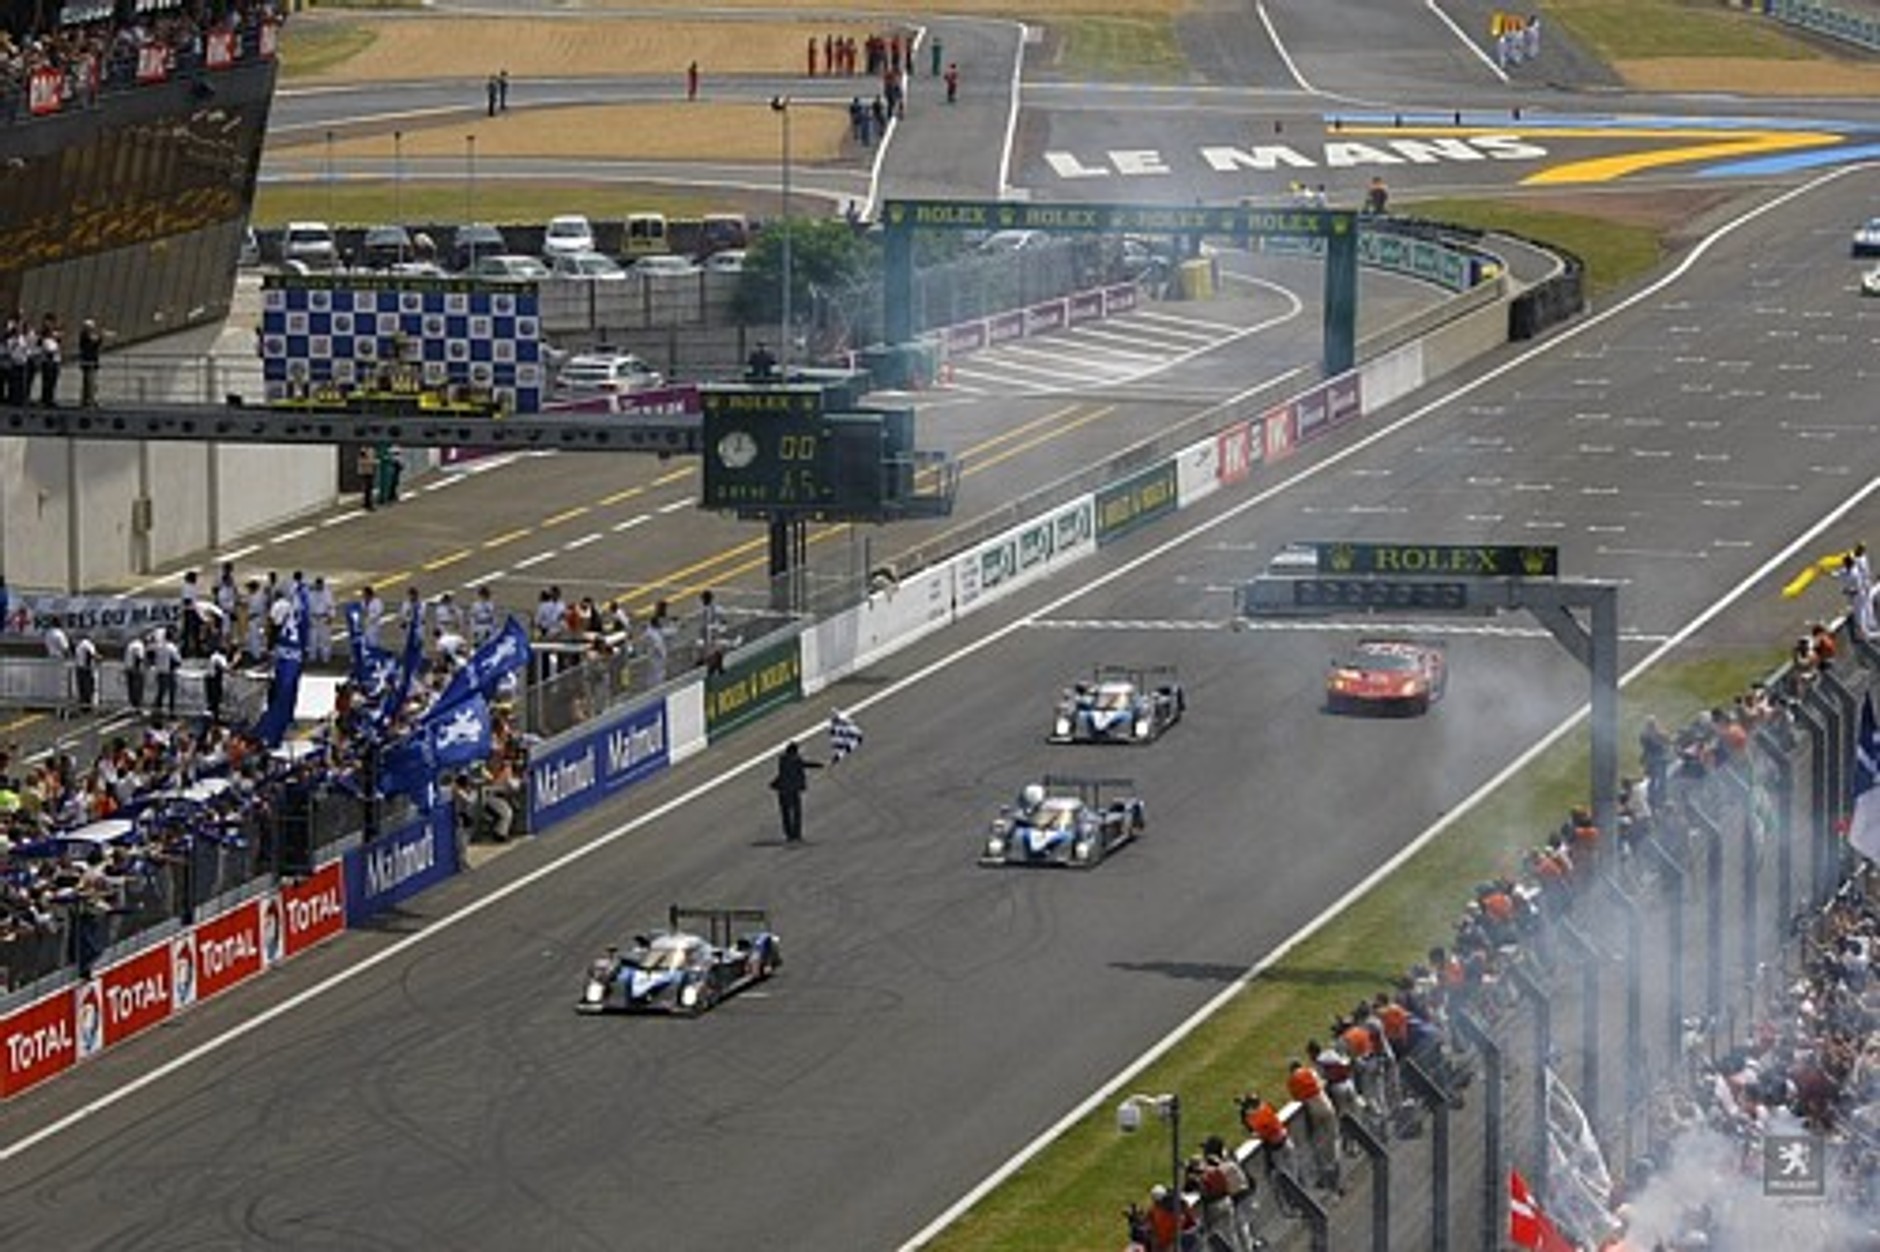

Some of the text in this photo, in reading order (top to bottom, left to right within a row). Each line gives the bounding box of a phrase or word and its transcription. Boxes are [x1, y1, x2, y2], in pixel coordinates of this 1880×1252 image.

[1043, 135, 1548, 178] LE MANS
[916, 206, 987, 224] ROLEX
[1026, 209, 1096, 227] ROLEX
[1249, 211, 1320, 232] ROLEX
[1375, 548, 1498, 571] ROLEX
[287, 886, 342, 934] TOTAL
[200, 928, 258, 977] TOTAL
[106, 972, 168, 1024] TOTAL
[7, 1018, 73, 1073] TOTAL
